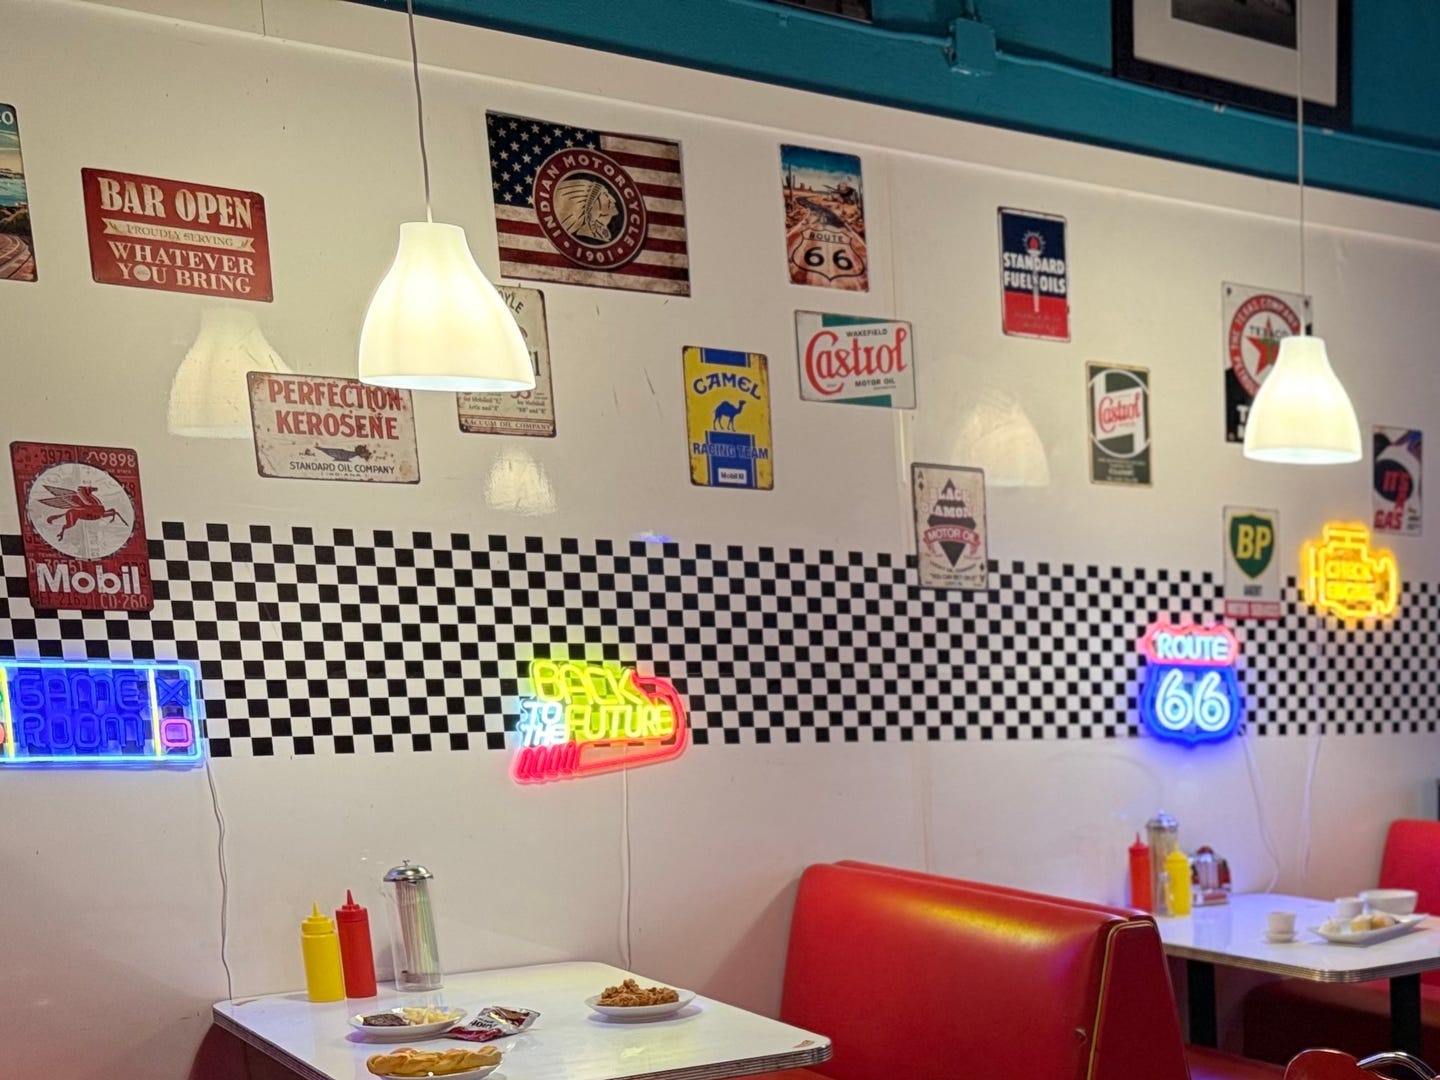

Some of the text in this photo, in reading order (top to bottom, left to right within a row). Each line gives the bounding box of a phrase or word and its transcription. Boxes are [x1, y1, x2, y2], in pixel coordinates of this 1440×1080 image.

[97, 176, 253, 230] BAR OPEN
[539, 154, 641, 248] INDIAN MOTORCYCLE
[127, 223, 234, 247] PROUDLY SERVING
[809, 231, 843, 243] ROUTE
[108, 240, 256, 276] WHATEVER
[575, 247, 614, 263] 1901
[803, 246, 854, 271] 66
[1003, 251, 1065, 275] STANDARD
[175, 268, 251, 294] BRING
[1004, 271, 1066, 294] FUEL OILS
[846, 328, 888, 338] WAKEFIELD
[805, 327, 907, 396] Castrol
[267, 379, 402, 412] PERFECTION
[693, 372, 761, 400] CAMEL
[855, 379, 881, 388] MOTOR
[883, 377, 896, 385] OIL
[275, 409, 400, 440] KEROSENE
[1098, 392, 1141, 433] Castrol
[693, 442, 769, 459] RACING TEAM
[289, 461, 395, 475] STANDARD OIL COMPANY
[929, 487, 971, 502] BLACK
[927, 527, 960, 541] MOTOR
[1237, 524, 1273, 560] BP
[36, 562, 141, 595] Mobil
[1156, 632, 1229, 661] ROUTE
[14, 673, 143, 711] GAME
[531, 660, 643, 705] BACK
[522, 699, 562, 723] TO
[1155, 668, 1231, 732] 66
[18, 713, 145, 749] ROOM
[521, 704, 674, 746] THE FUTURE
